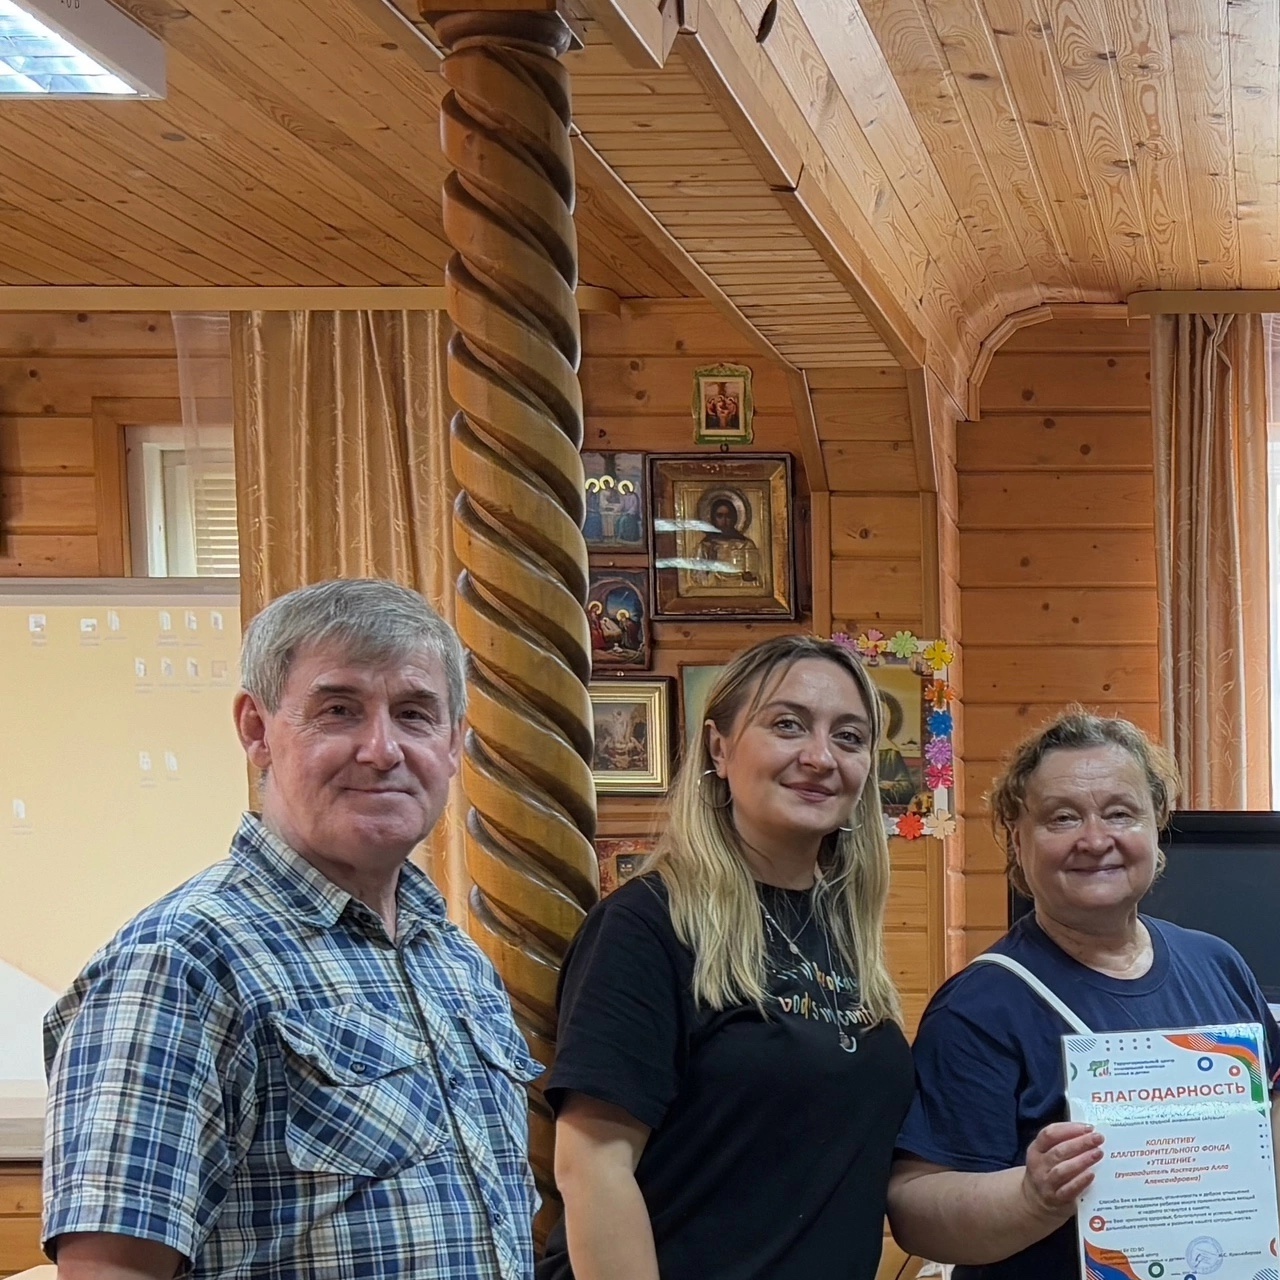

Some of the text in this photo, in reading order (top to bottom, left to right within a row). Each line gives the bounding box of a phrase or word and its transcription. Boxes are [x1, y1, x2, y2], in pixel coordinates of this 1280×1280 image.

[1091, 1082, 1245, 1103] БЛАГОДАРНОСТЬ
[1146, 1136, 1196, 1146] КОЛЛЕКТИВУ
[1110, 1143, 1230, 1159] БЛАГОТВОРИТЕЛЬНОГО ФОНДА
